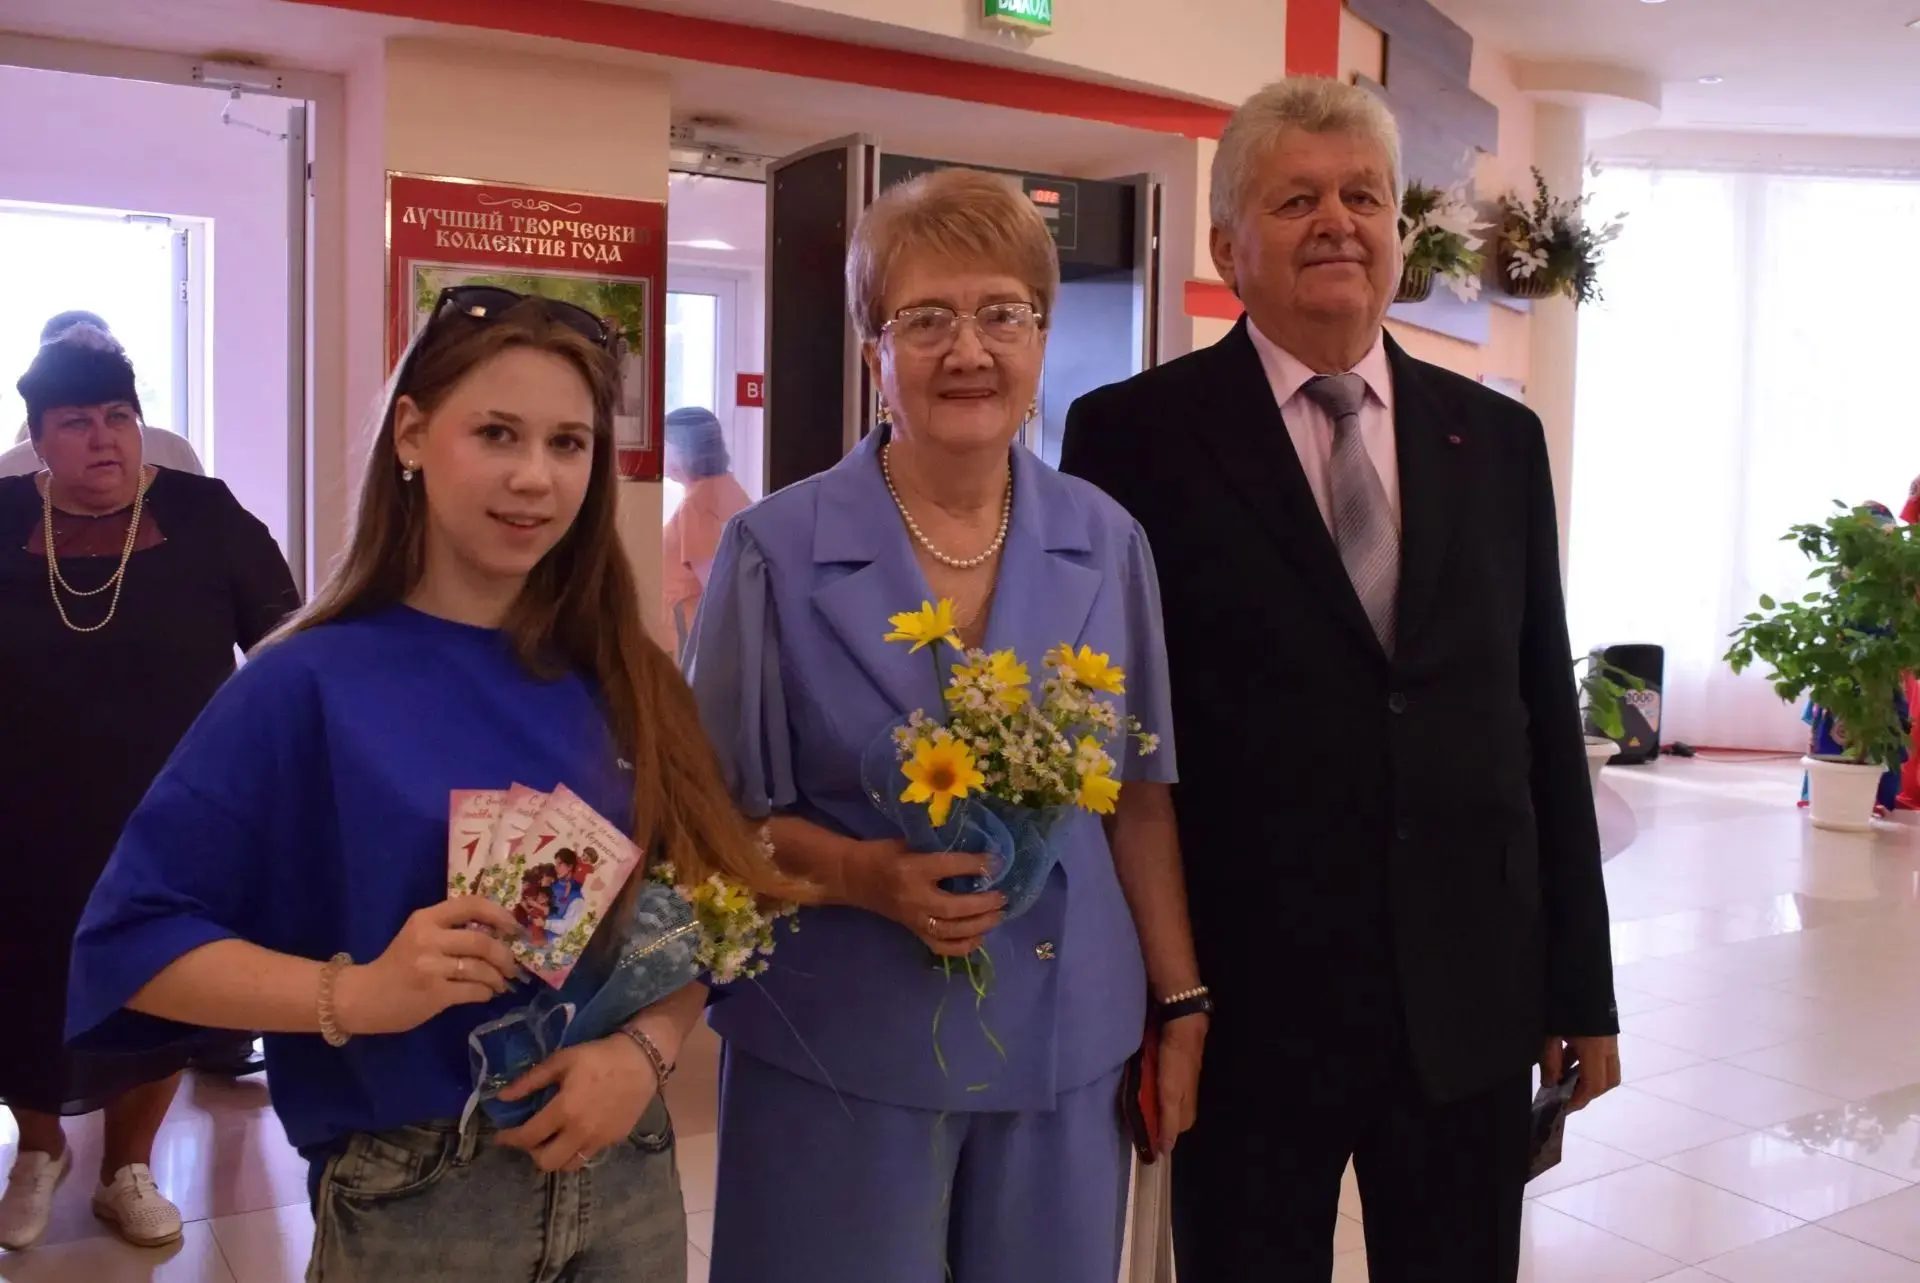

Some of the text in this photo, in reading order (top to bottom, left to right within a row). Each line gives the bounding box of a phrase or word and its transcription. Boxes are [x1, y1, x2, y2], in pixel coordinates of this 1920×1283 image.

[402, 206, 504, 231] ЛУЧШИЙ
[435, 229, 623, 264] КОЛЛЕКТИВ ГОДА
[747, 382, 764, 399] В
